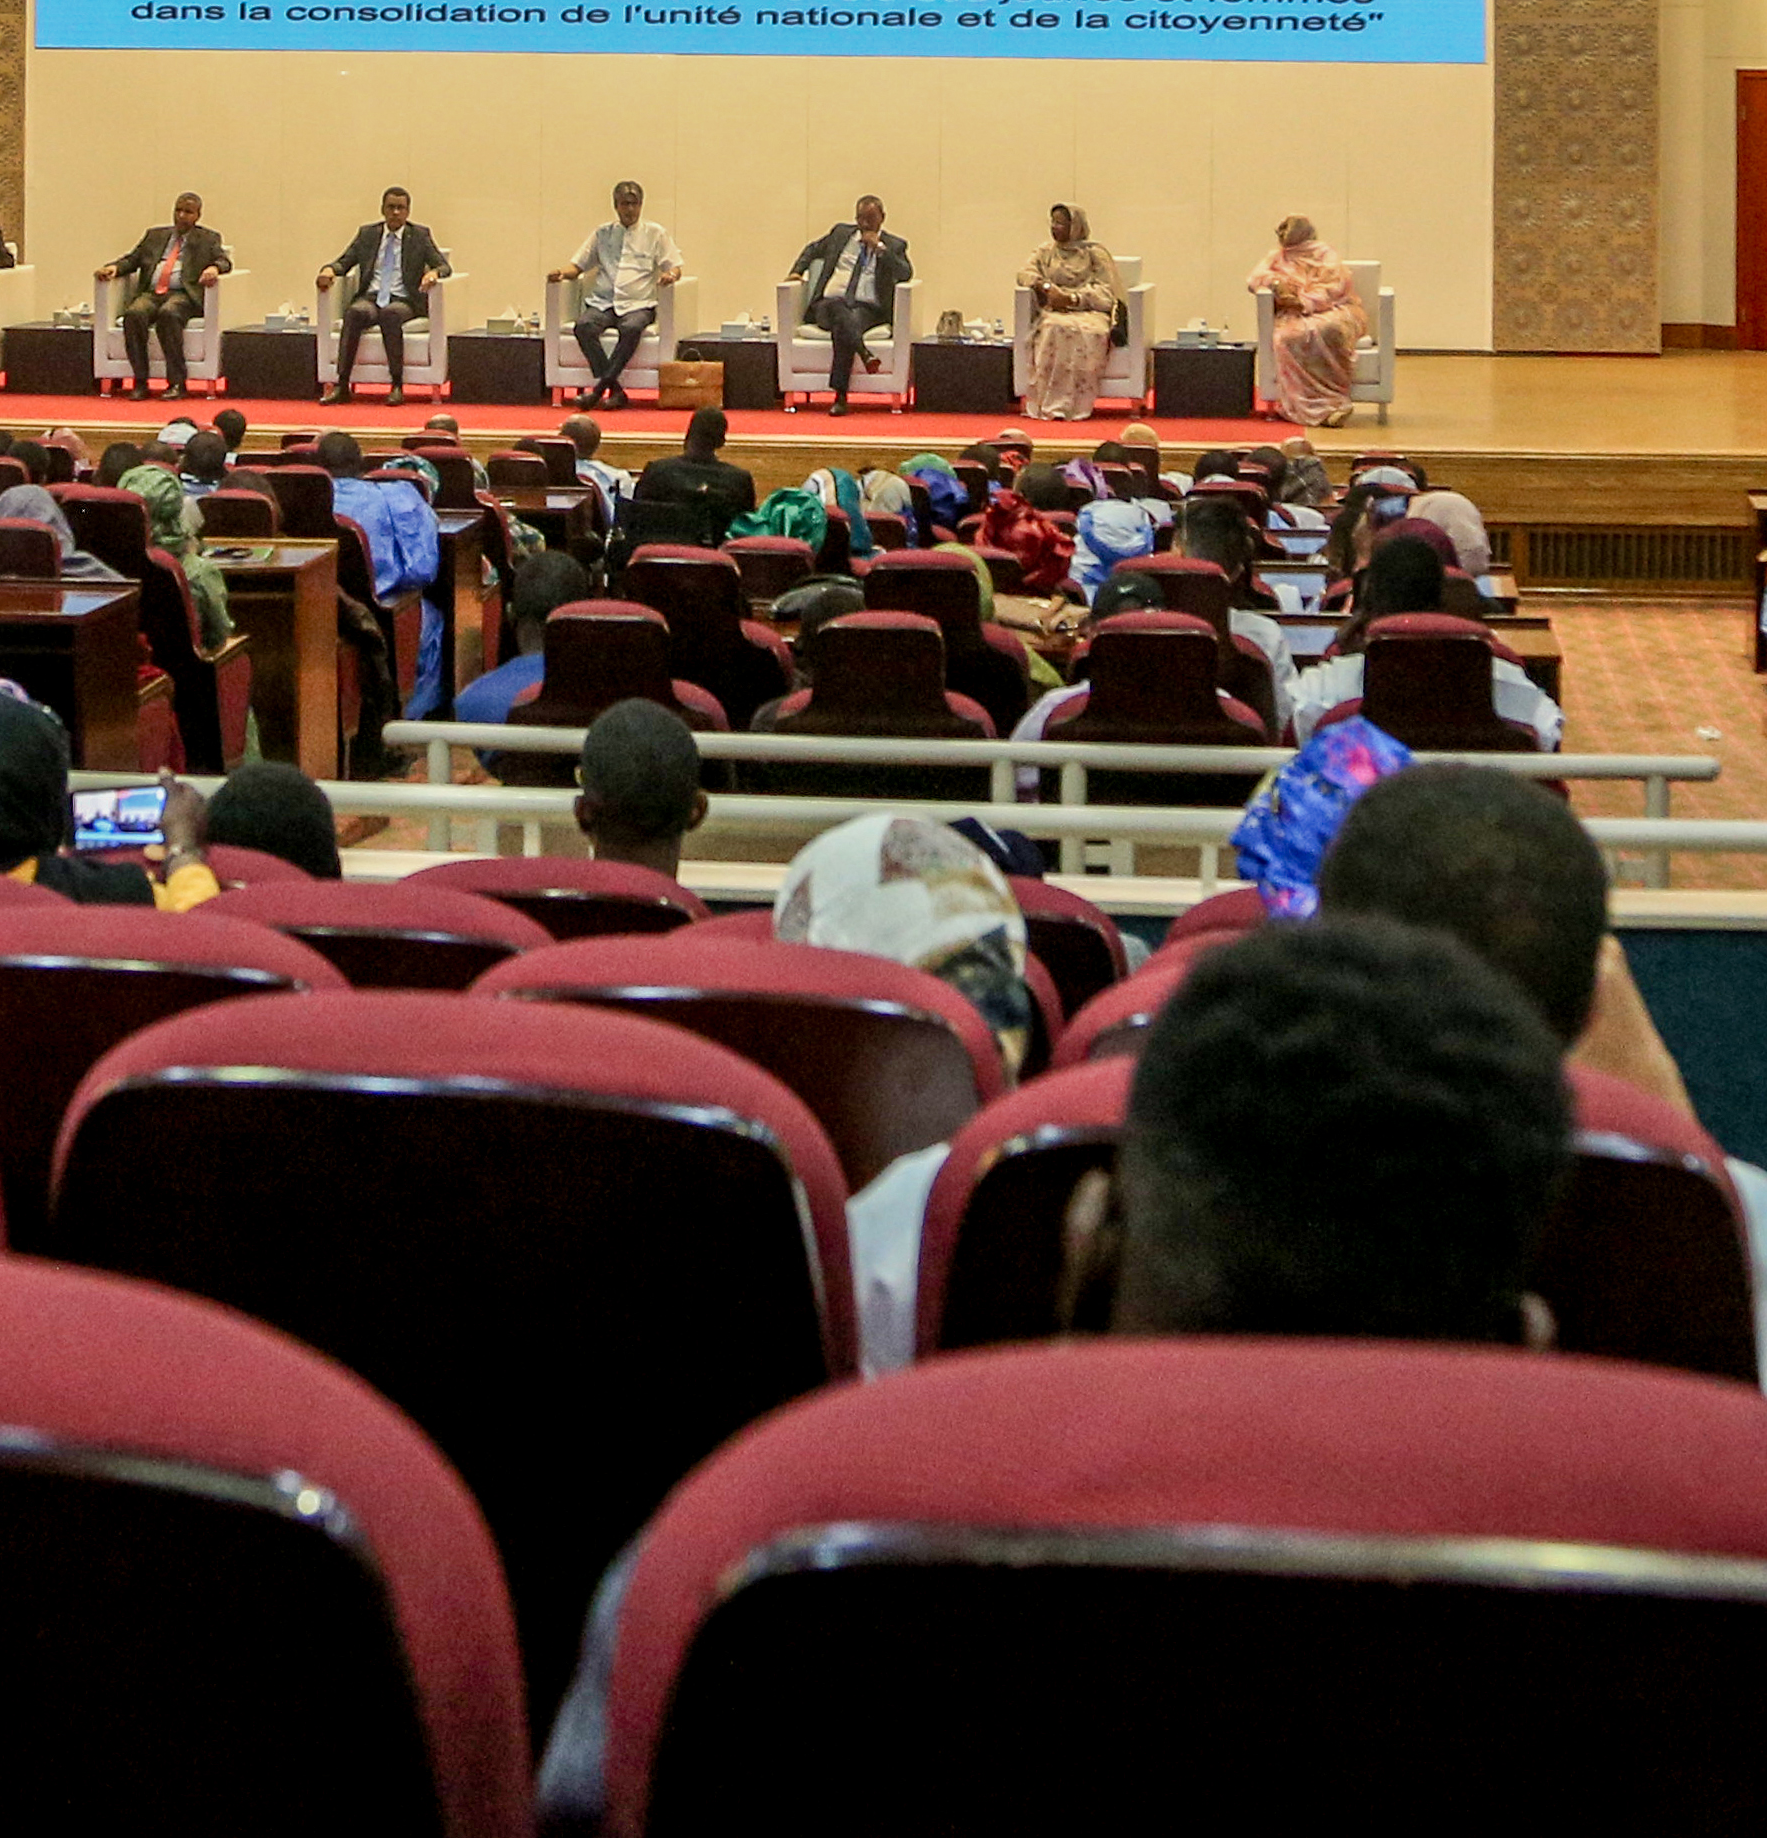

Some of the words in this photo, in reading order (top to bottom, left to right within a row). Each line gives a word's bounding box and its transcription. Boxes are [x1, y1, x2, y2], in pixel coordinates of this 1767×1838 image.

[131, 2, 226, 20] dans
[239, 2, 272, 20] la
[285, 3, 547, 23] consolidation
[560, 5, 610, 23] de
[756, 7, 943, 27] nationale
[957, 9, 997, 28] et
[1009, 9, 1060, 29] de
[1075, 9, 1110, 29] la
